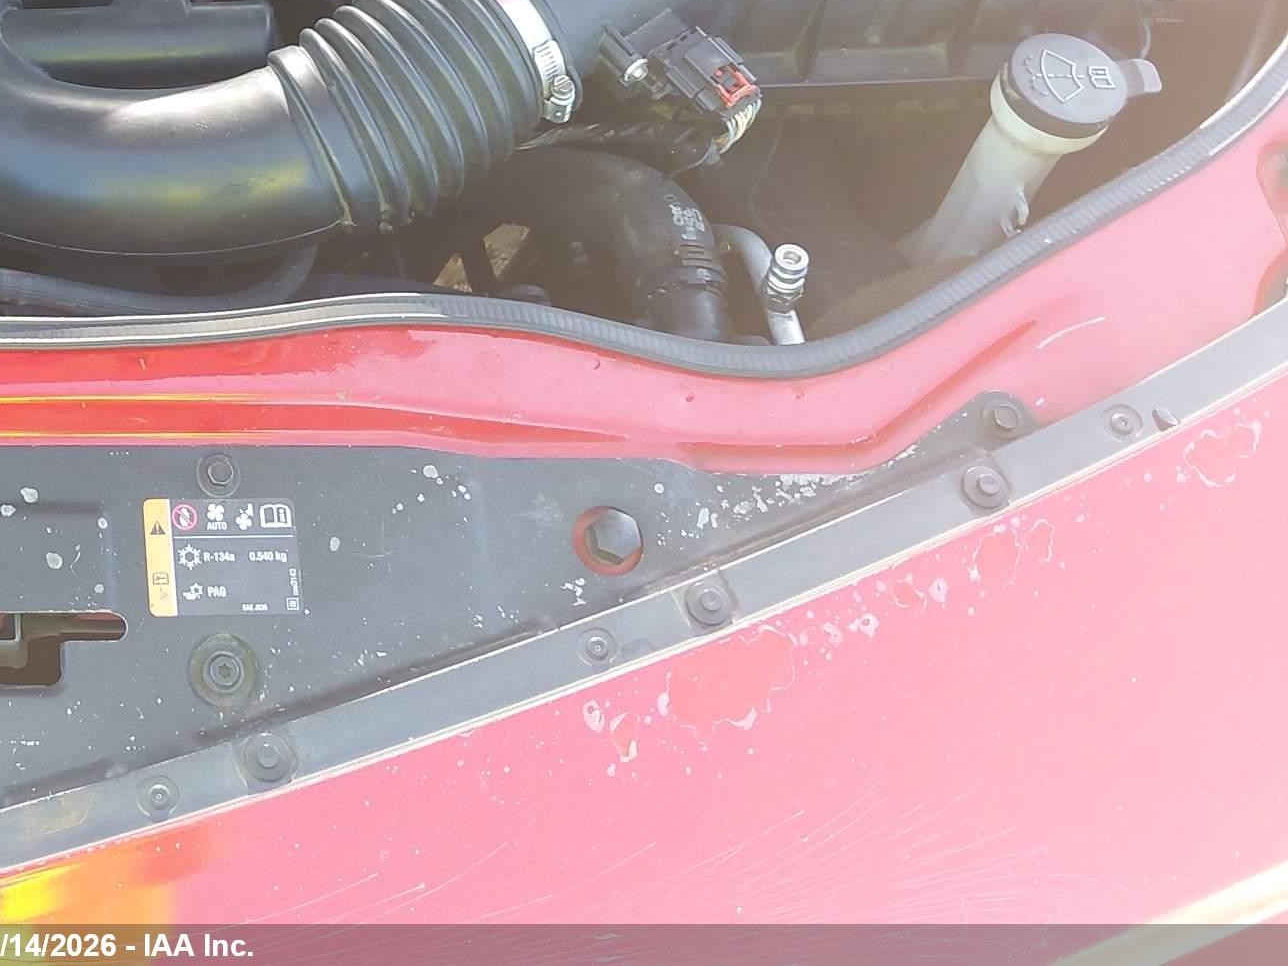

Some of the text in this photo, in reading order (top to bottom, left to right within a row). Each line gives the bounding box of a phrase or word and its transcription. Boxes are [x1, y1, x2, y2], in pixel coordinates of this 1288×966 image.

[207, 522, 227, 530] AUTO
[203, 551, 288, 563] R-134a 0.540 kg
[207, 586, 227, 597] PAG
